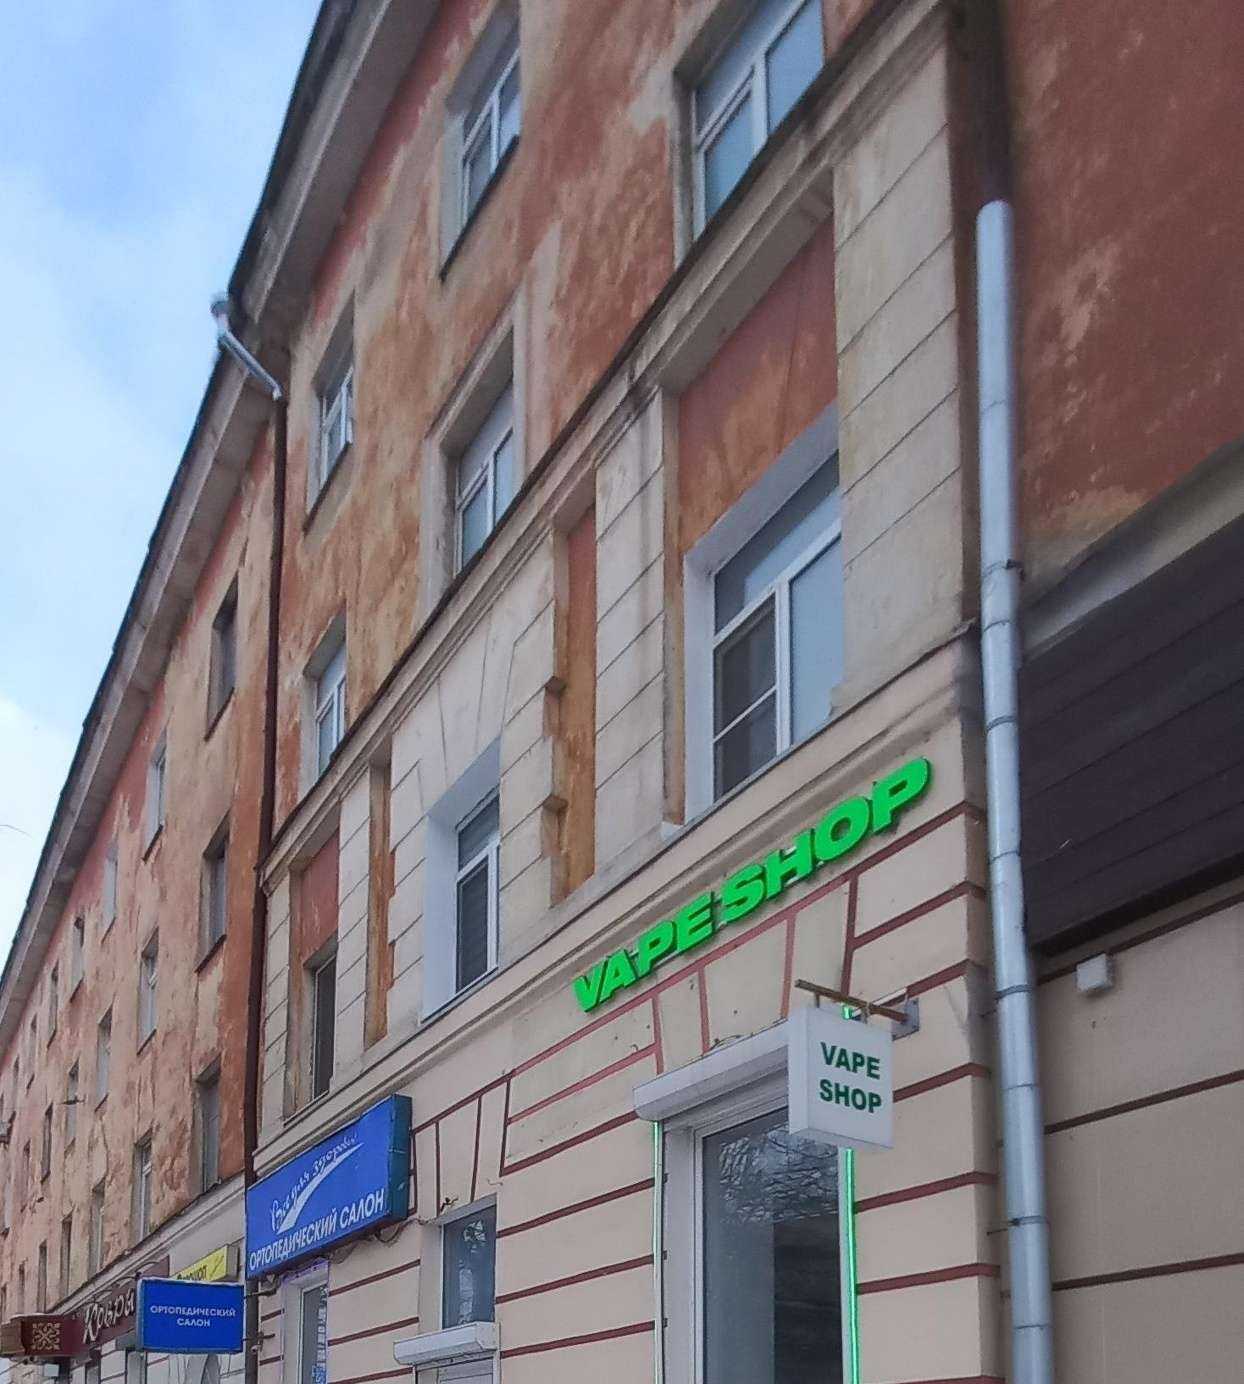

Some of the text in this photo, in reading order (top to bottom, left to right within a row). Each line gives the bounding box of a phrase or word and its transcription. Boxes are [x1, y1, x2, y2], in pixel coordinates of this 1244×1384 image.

[572, 756, 932, 1013] VAPE SHOP
[820, 1041, 881, 1080] VAPE
[819, 1079, 882, 1113] SHOP
[249, 1187, 386, 1271] ОРТОПЕДИЧЕСКИЙ САЛОН
[150, 1304, 237, 1317] ОРТОПЕДИЧЕСКИЙ
[176, 1317, 211, 1327] САЛОН
